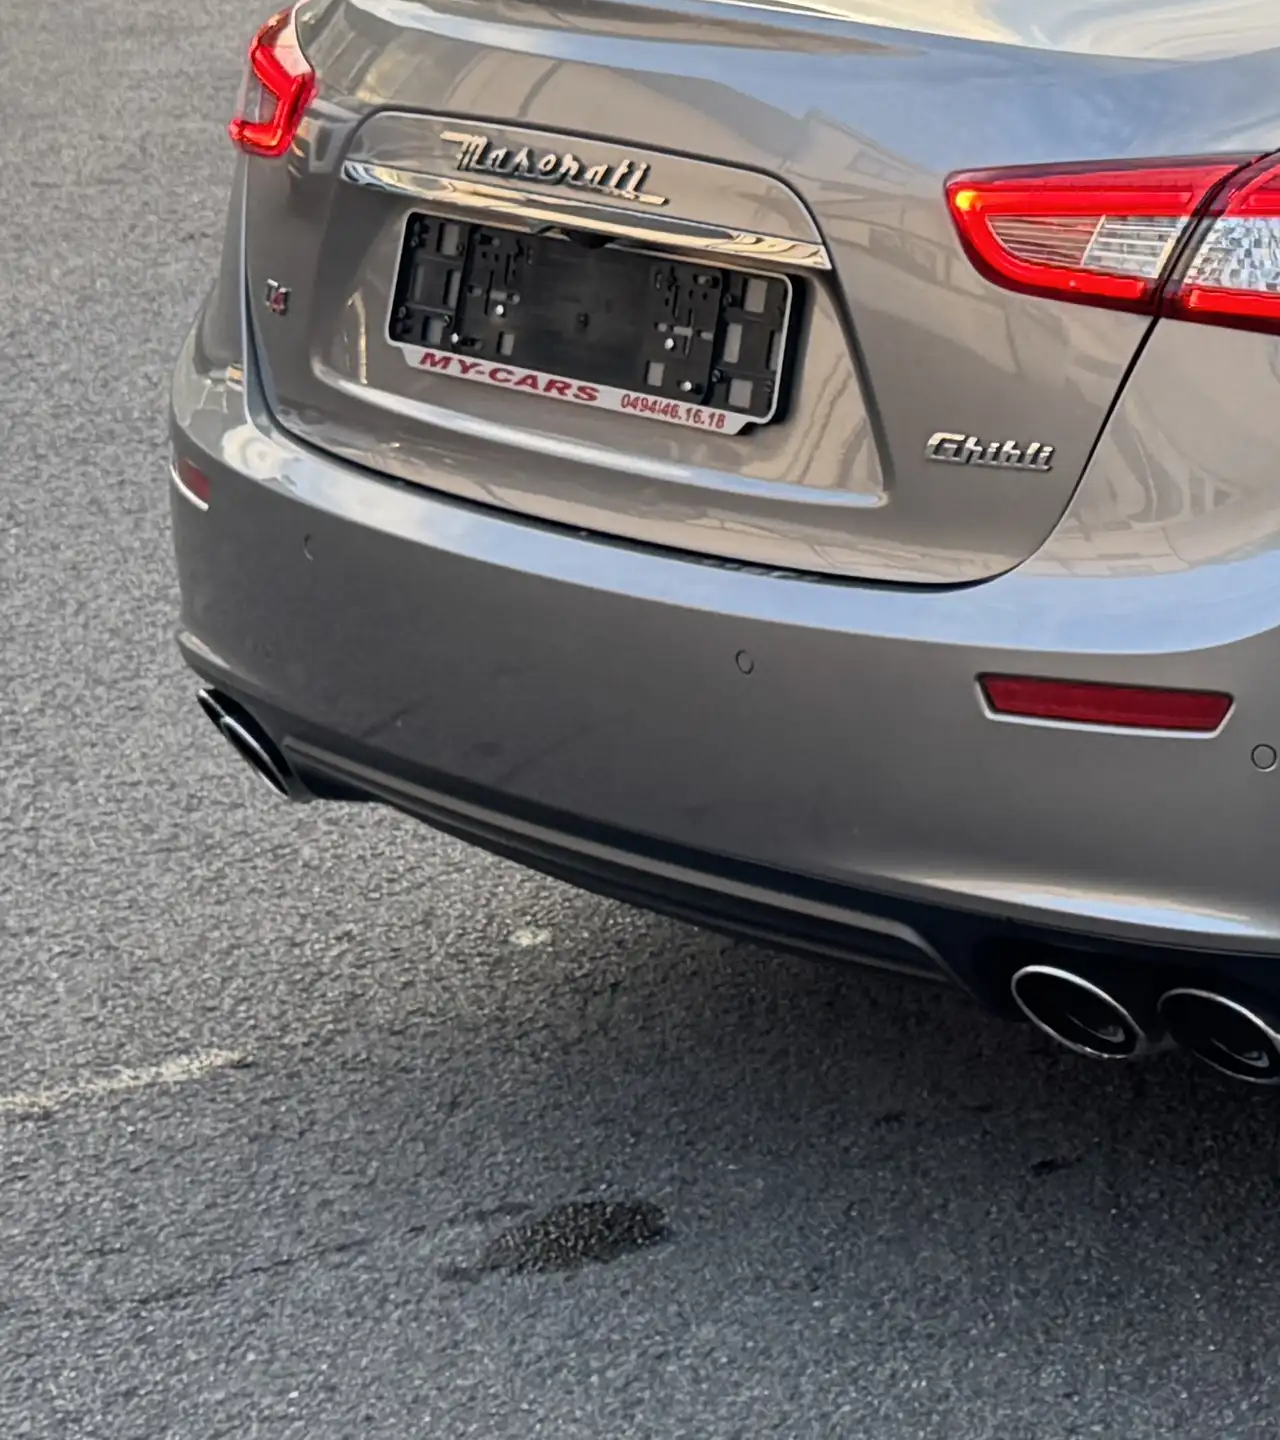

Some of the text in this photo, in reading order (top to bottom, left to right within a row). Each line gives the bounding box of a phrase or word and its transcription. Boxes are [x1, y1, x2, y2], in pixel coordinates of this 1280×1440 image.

[440, 131, 669, 206] Maserati
[419, 351, 599, 402] MY-CARS
[924, 431, 1054, 472] Ghibli
